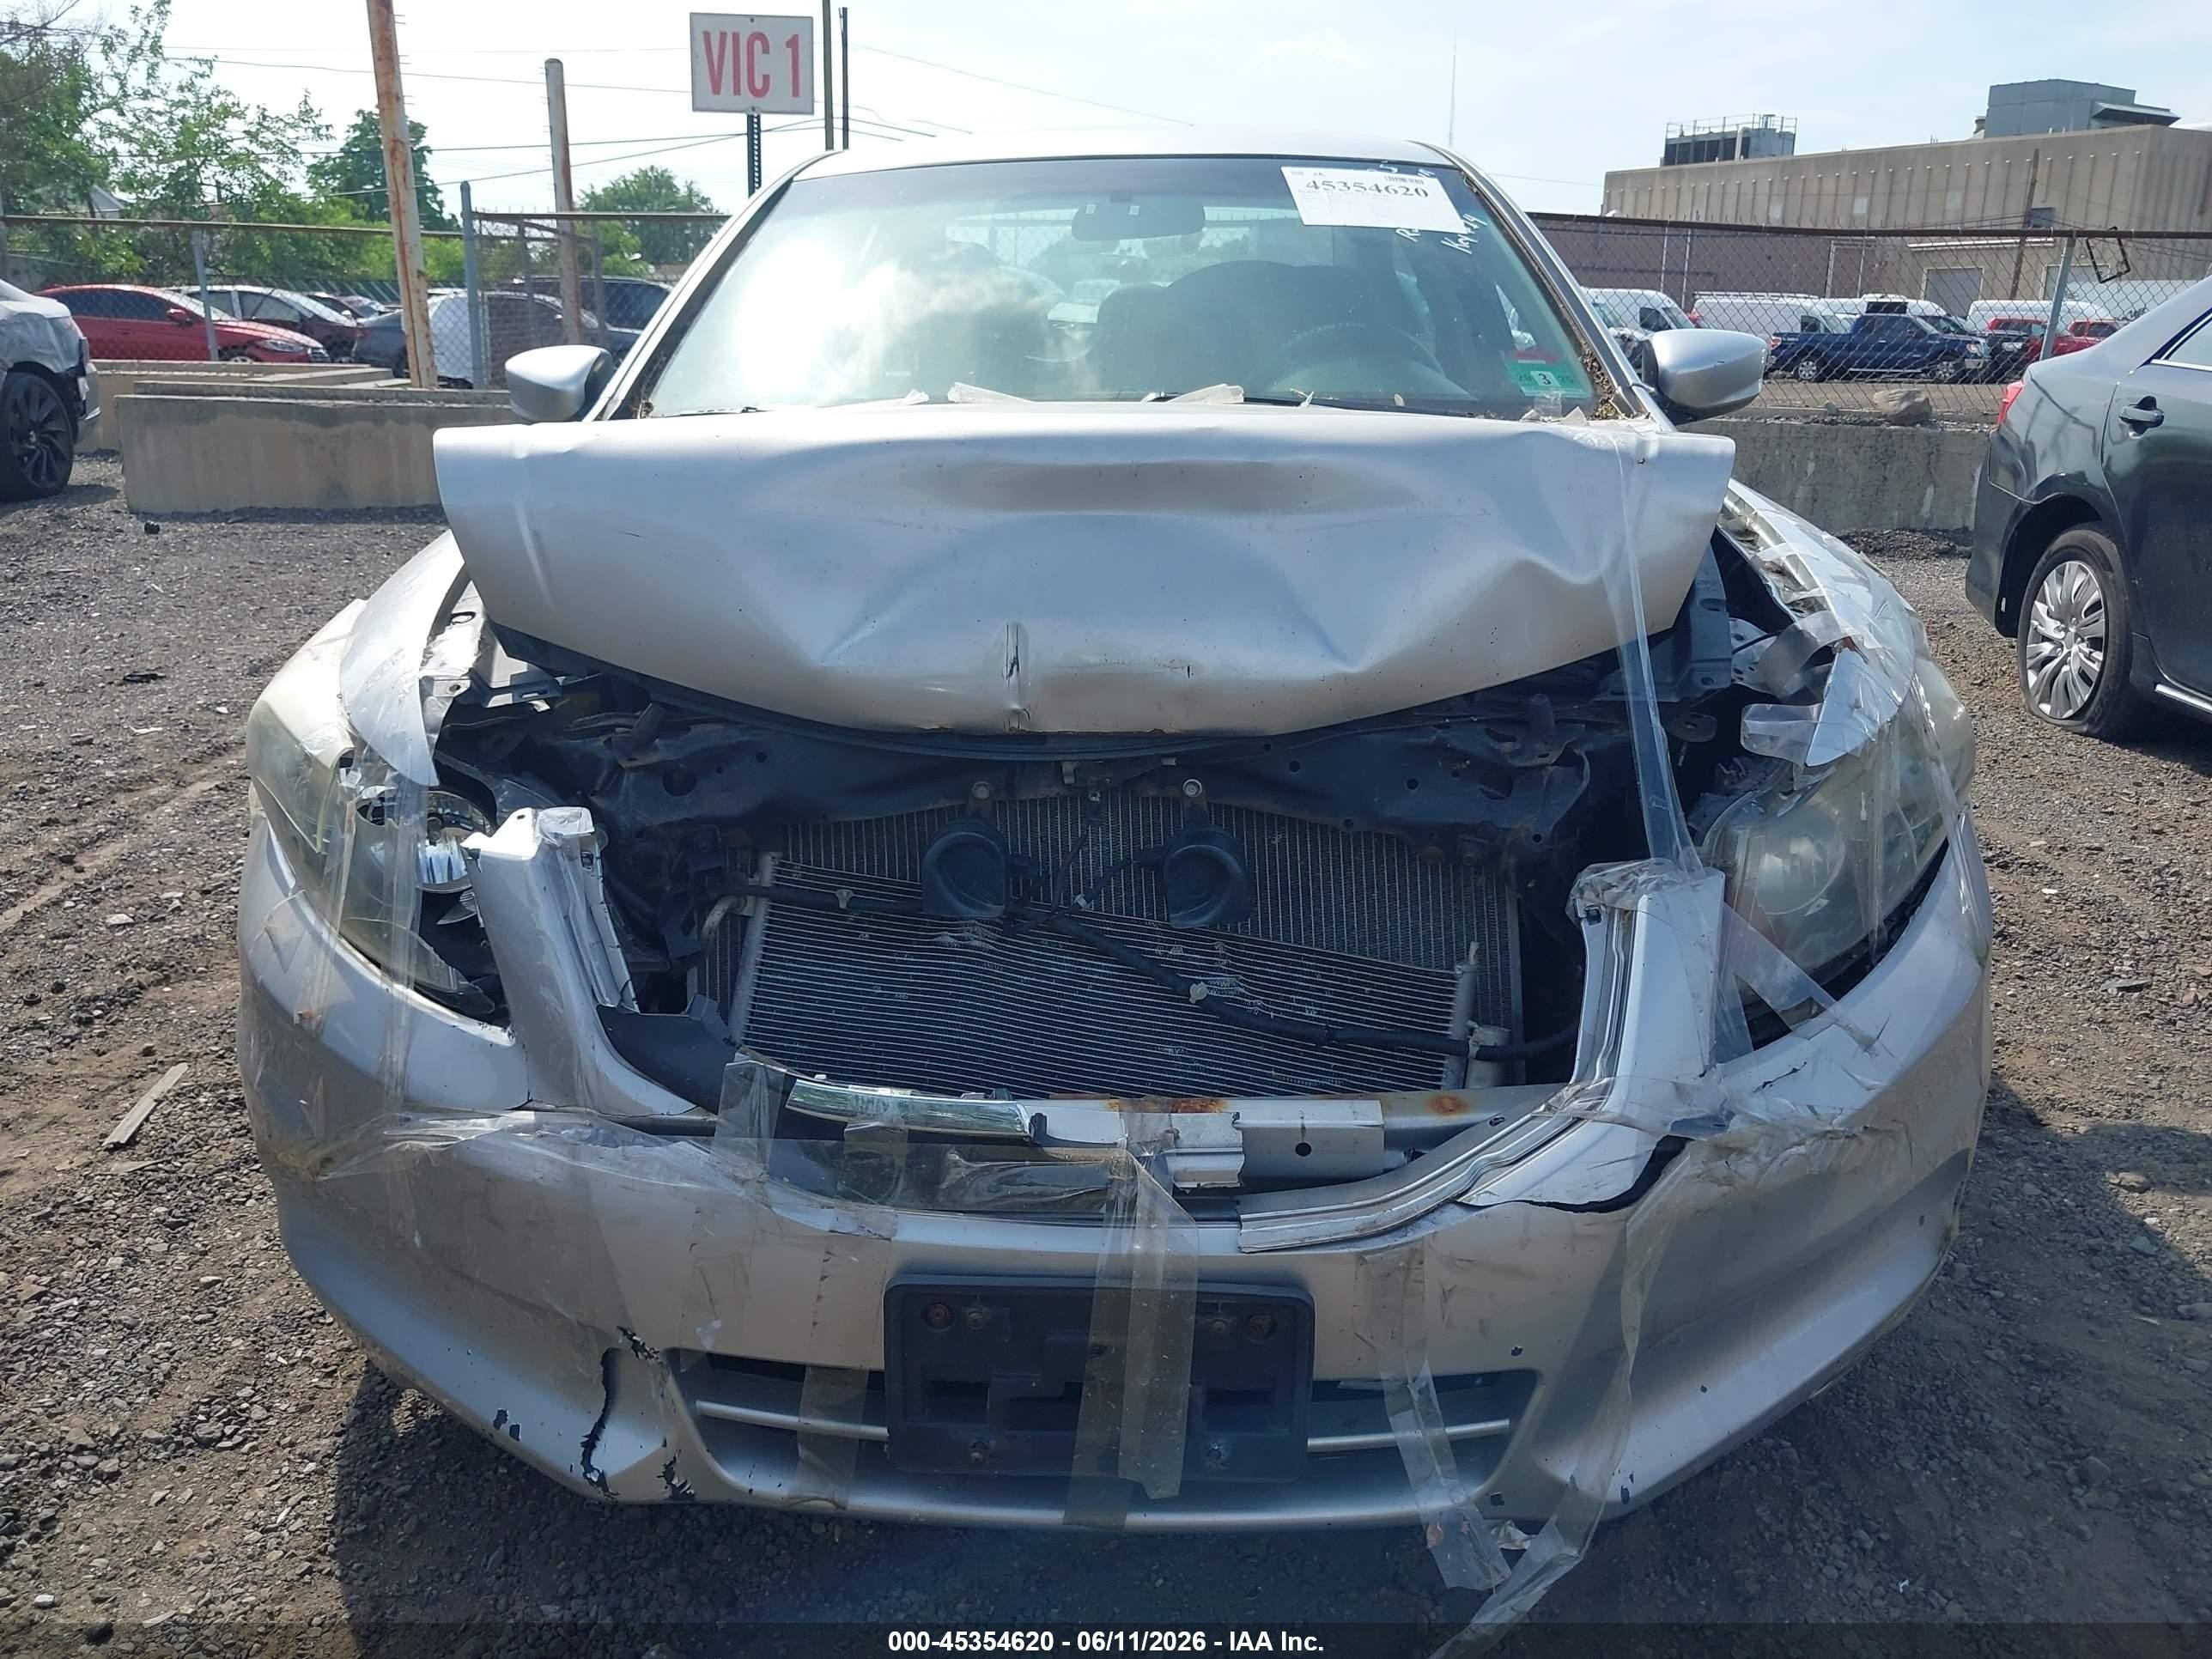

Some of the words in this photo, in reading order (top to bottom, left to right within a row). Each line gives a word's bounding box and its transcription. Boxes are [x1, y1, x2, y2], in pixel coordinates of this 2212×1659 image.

[702, 31, 771, 99] VIC
[785, 33, 800, 98] 1
[1305, 179, 1430, 198] 45354620
[1538, 373, 1552, 386] 3
